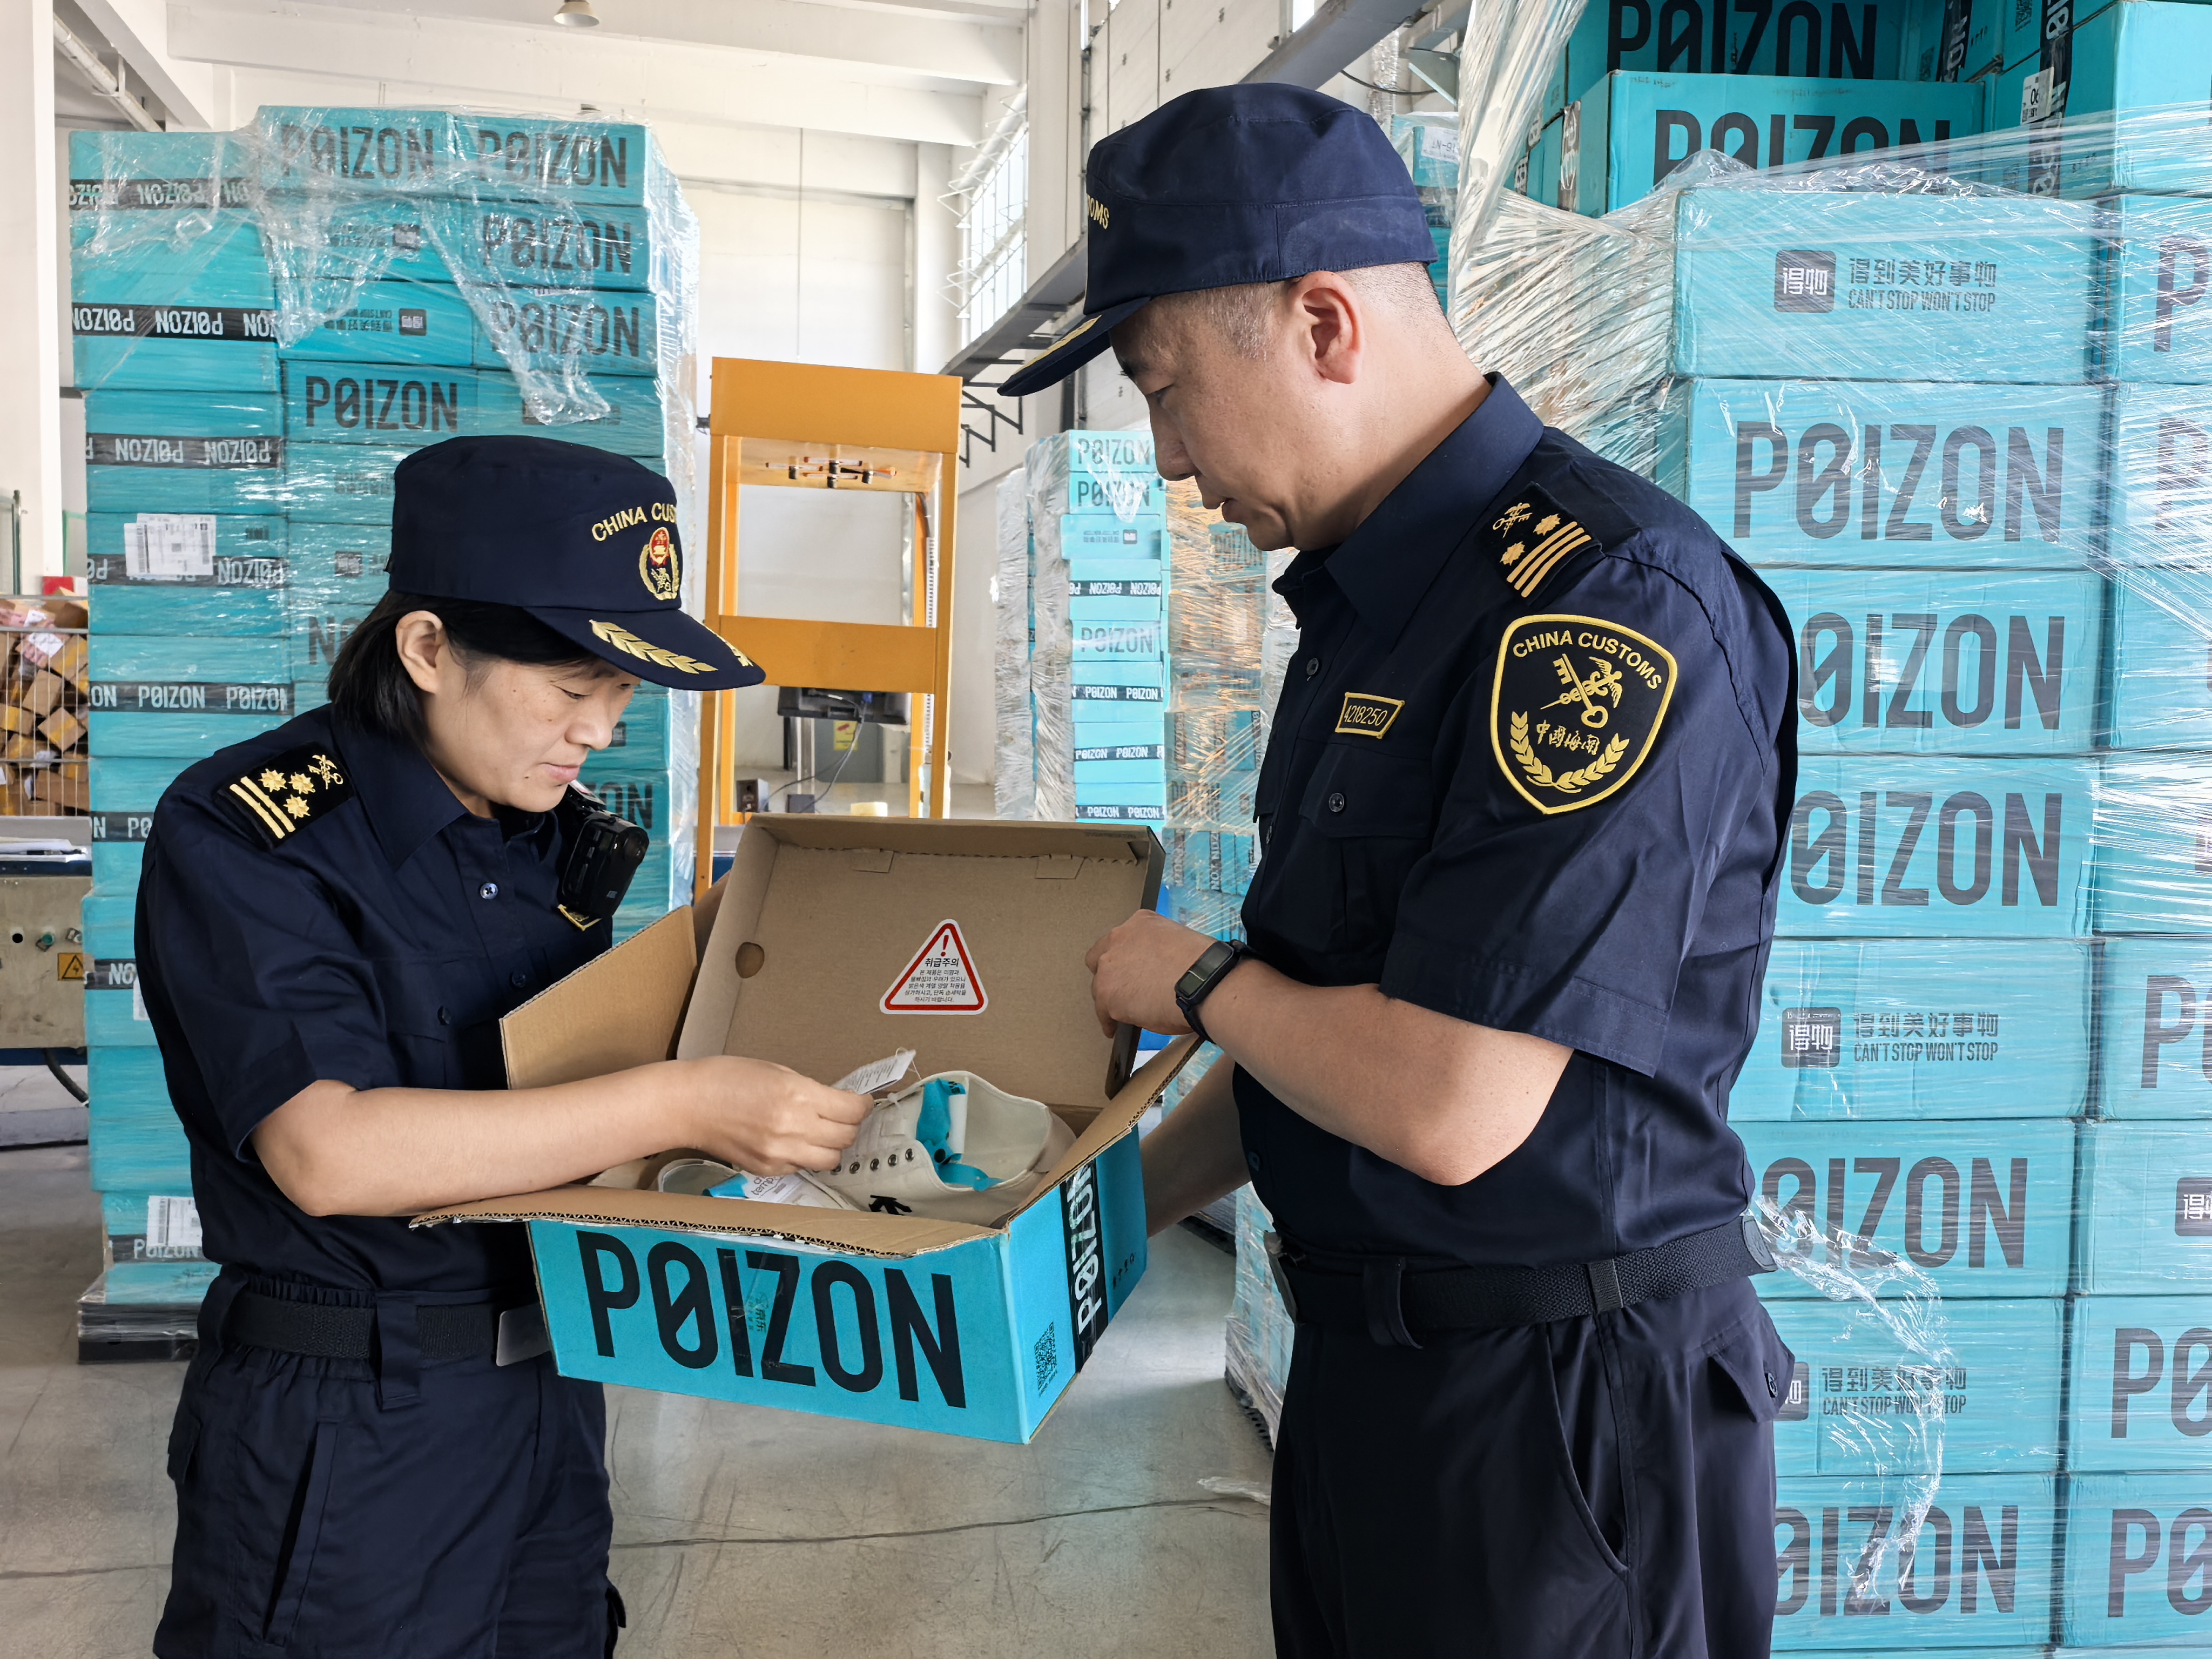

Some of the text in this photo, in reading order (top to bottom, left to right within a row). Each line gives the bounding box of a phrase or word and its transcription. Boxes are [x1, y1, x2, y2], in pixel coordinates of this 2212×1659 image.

[1783, 267, 1829, 295] 得物
[1849, 258, 1997, 287] 得到美好事物
[1849, 290, 1996, 312] CAN'T STOP WON'T STOP
[592, 507, 647, 542] CHINA
[1513, 630, 1662, 690] CHINA CUSTOMS
[1344, 705, 1388, 726] 4218250
[925, 957, 959, 967] 취급주의
[1790, 1024, 1833, 1051] 得物
[1854, 1011, 1999, 1038] 得到美好事物
[1854, 1042, 1998, 1062] CAN'T STOP WON'T STOP
